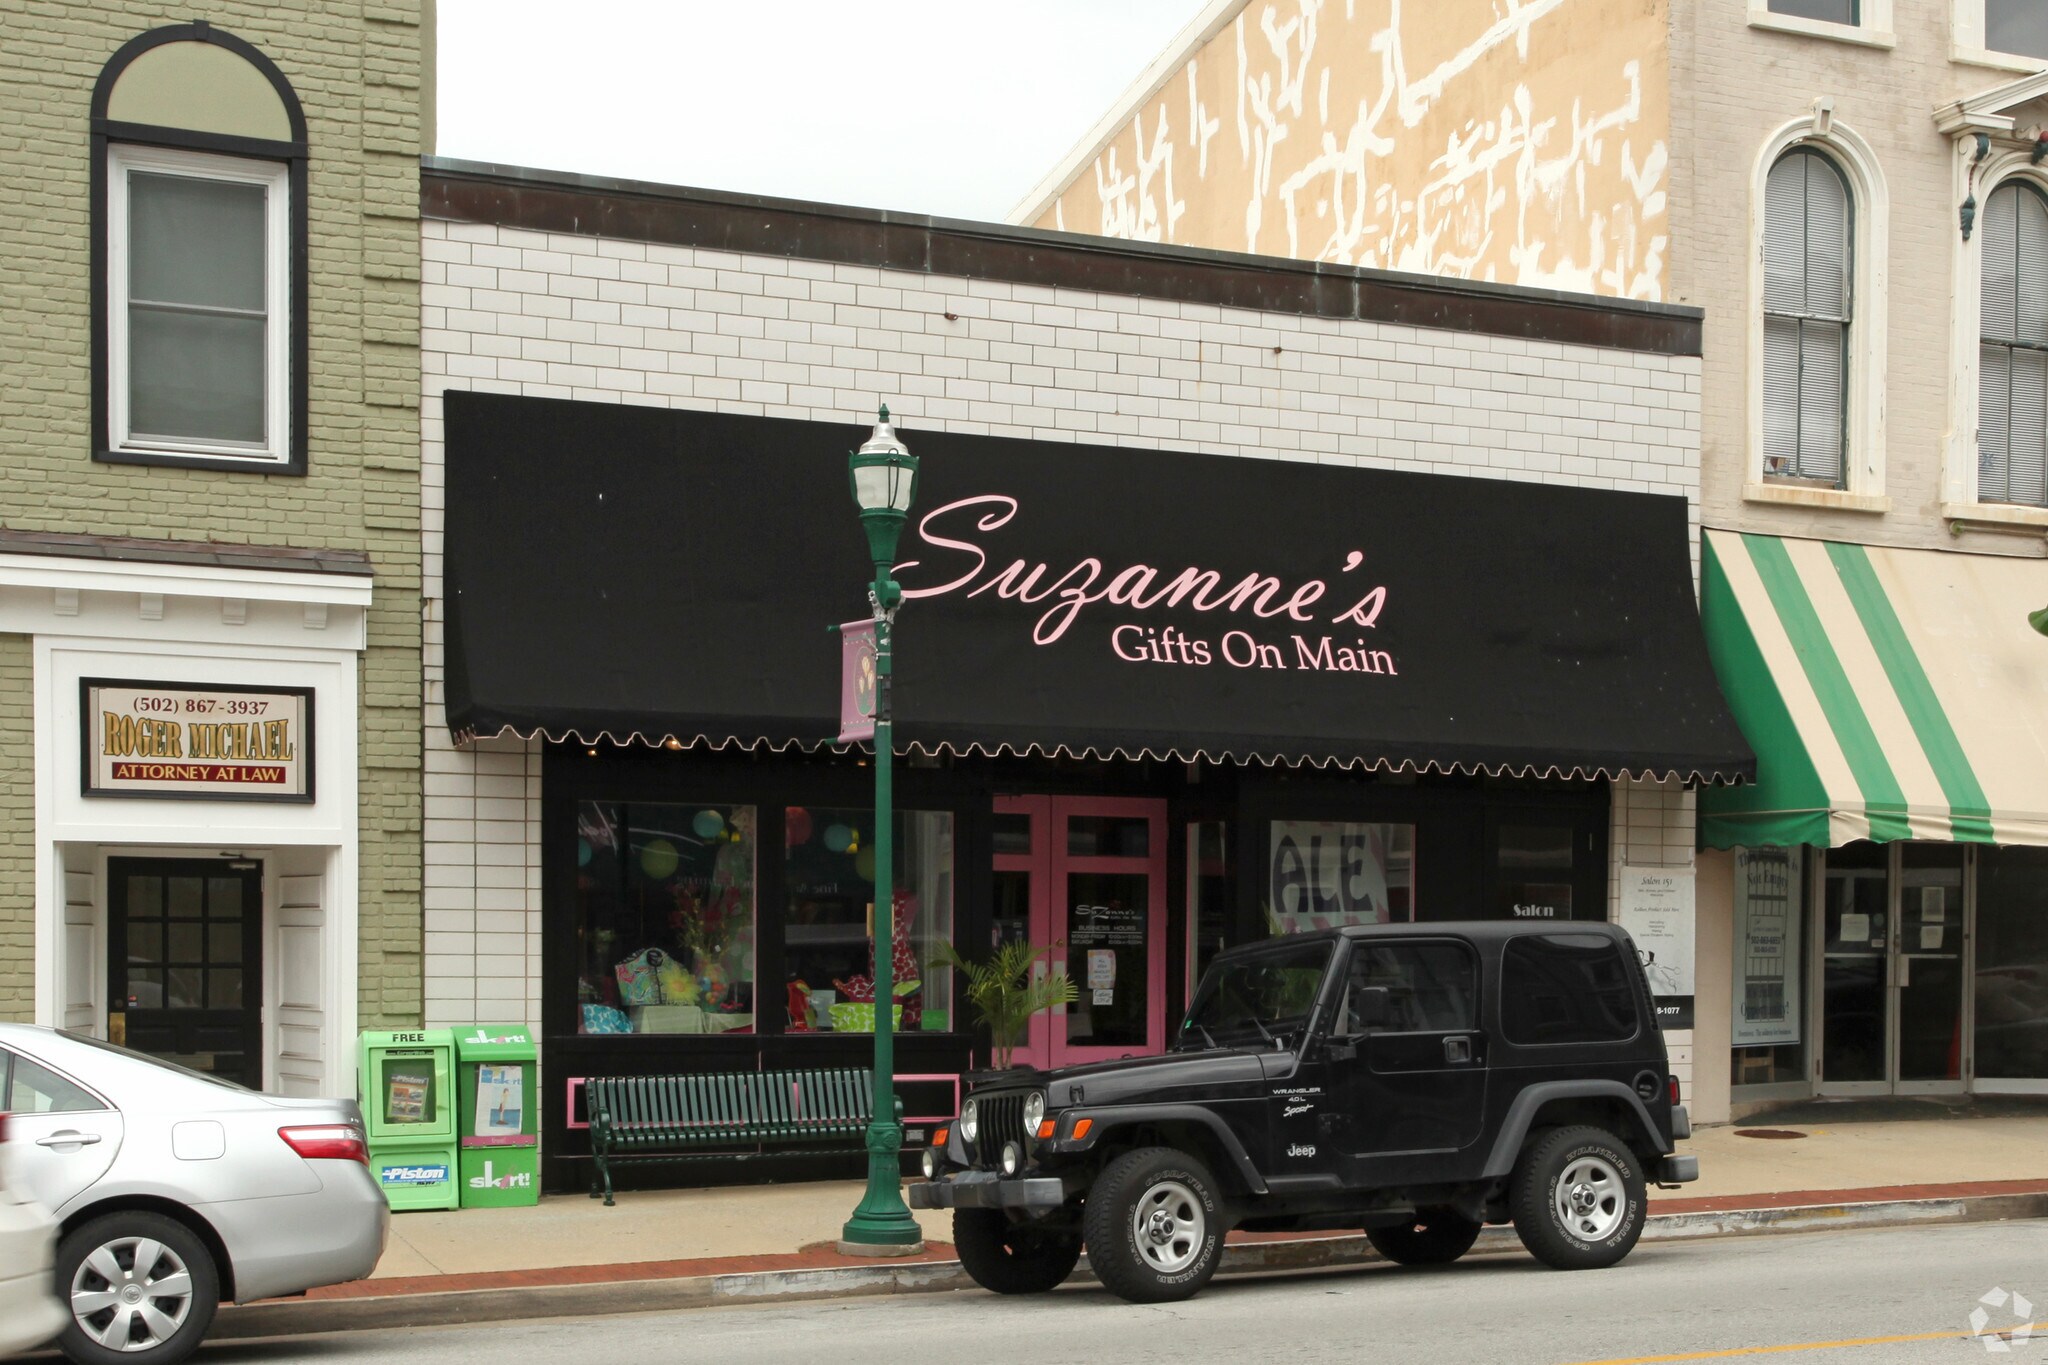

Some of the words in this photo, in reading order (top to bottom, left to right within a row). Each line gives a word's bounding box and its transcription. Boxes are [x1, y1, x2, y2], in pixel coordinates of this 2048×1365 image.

[890, 494, 1387, 646] Suzanne's
[1111, 624, 1212, 666] Gifts
[1221, 630, 1287, 670] On
[1292, 633, 1398, 676] Main
[133, 696, 179, 714] (502)
[185, 699, 269, 716] 867-3937
[103, 710, 183, 759] ROGER
[188, 718, 294, 762] MICHAEL
[117, 764, 211, 780] ATTORNEY
[216, 766, 237, 780] AT
[242, 767, 281, 782] LAW
[1641, 876, 1661, 886] Salon
[1513, 904, 1554, 917] Salon
[392, 1033, 425, 1042] FREE
[1272, 1086, 1322, 1095] WRANGLER
[1283, 1103, 1315, 1118] Sport
[1287, 1145, 1316, 1158] Jeep
[1566, 1146, 1631, 1179] WRANGLER
[389, 1167, 445, 1180] Piston
[1145, 1169, 1214, 1212] GOODYEAR
[1606, 1200, 1637, 1248] RADIAL
[1157, 1235, 1216, 1284] WRANGLER
